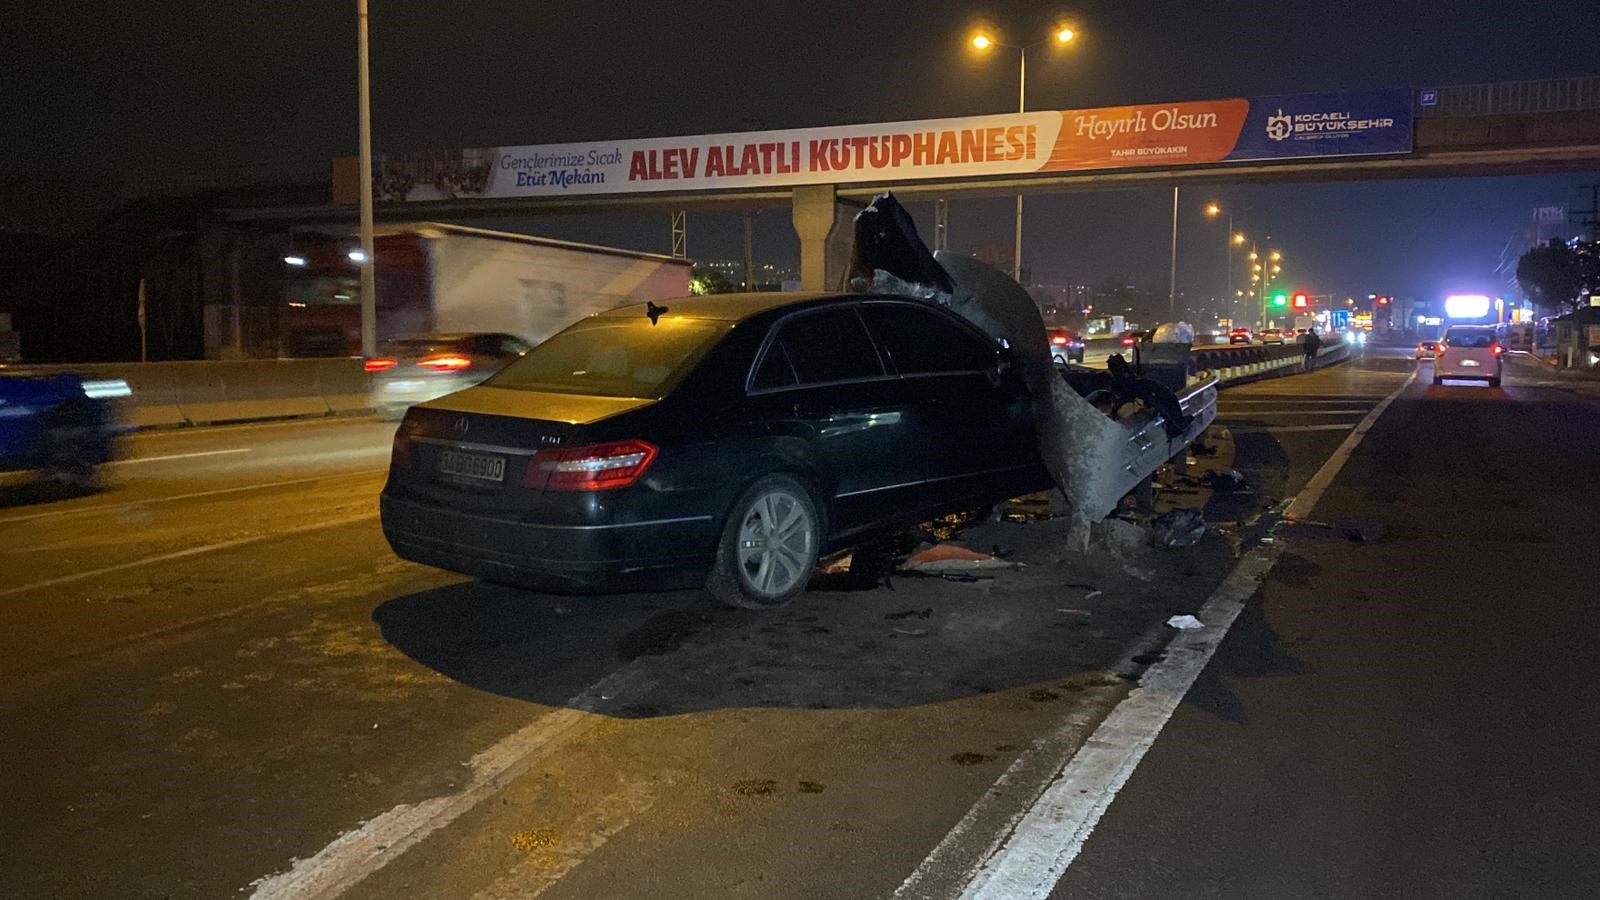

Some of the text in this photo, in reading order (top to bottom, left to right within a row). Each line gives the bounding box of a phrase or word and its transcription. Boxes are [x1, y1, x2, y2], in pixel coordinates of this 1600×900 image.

[1075, 108, 1217, 140] Hayırlı Olsun
[1295, 118, 1393, 132] BÜYÜKŞEHİR
[501, 148, 622, 171] Gençlerimize Sıcak
[628, 147, 699, 181] ALEV
[704, 141, 800, 177] ALATLI
[516, 168, 605, 188] Etüt Mekânı
